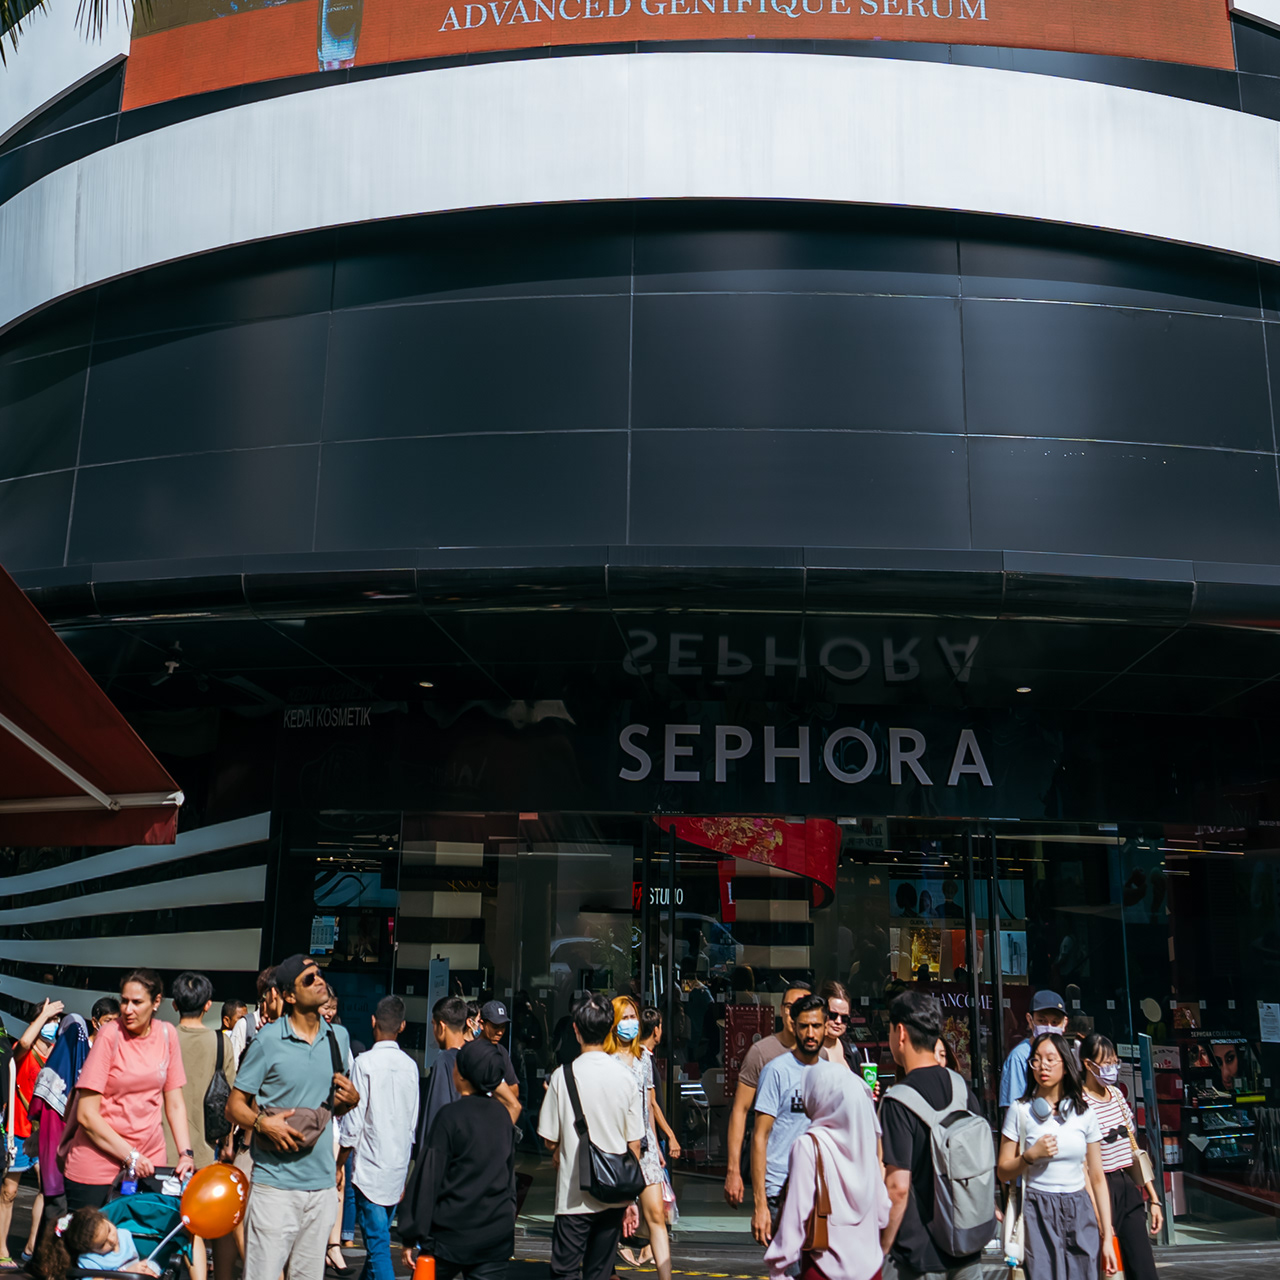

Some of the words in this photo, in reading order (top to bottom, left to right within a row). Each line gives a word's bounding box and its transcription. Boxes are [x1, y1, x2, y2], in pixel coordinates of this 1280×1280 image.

[283, 708, 314, 728] KEDAI
[316, 706, 371, 727] KOSMETIK
[618, 724, 994, 787] SEPHORA
